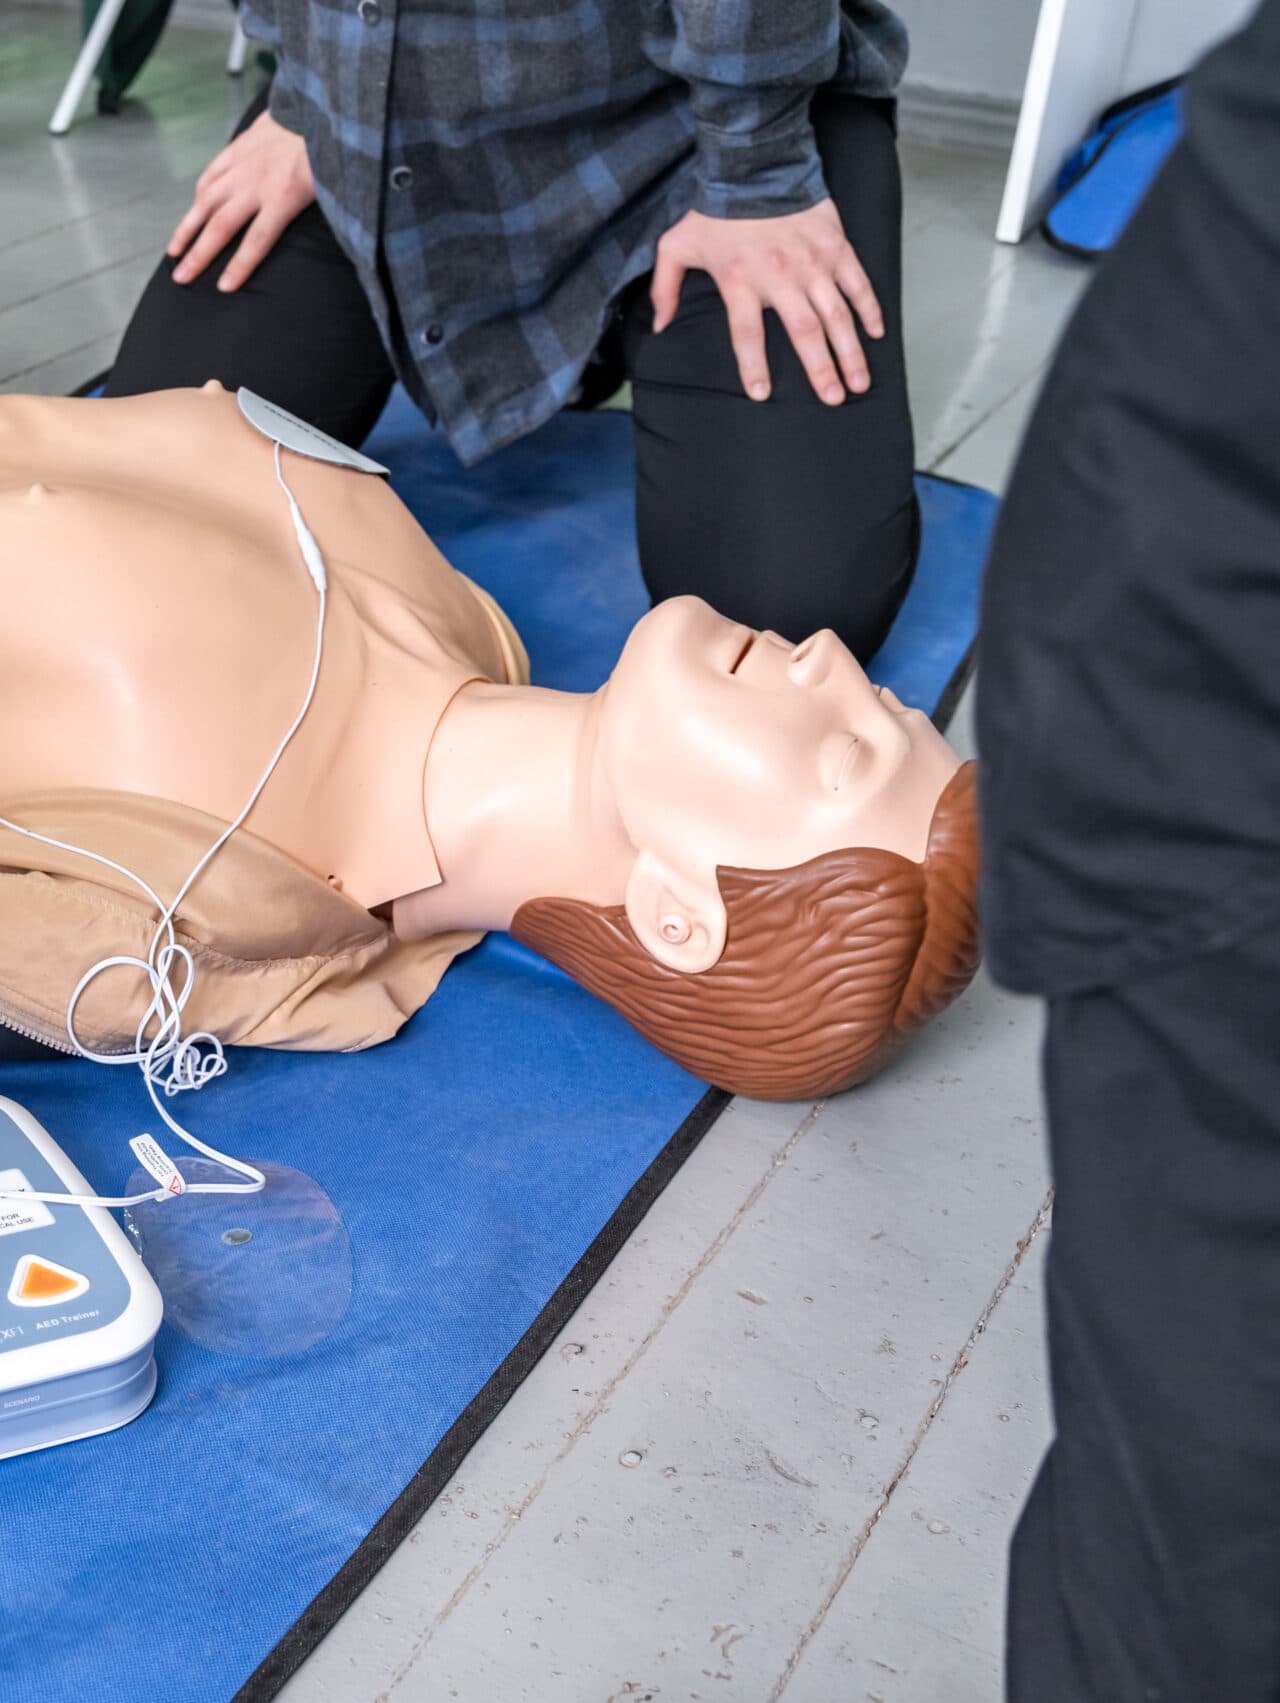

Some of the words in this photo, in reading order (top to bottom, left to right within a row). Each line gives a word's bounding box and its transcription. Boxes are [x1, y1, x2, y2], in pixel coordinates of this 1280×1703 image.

[1, 1212, 20, 1222] FOR
[15, 1215, 34, 1226] USE
[35, 1317, 60, 1331] AED
[61, 1309, 100, 1324] Trainer
[3, 1395, 40, 1408] SCENARIO
